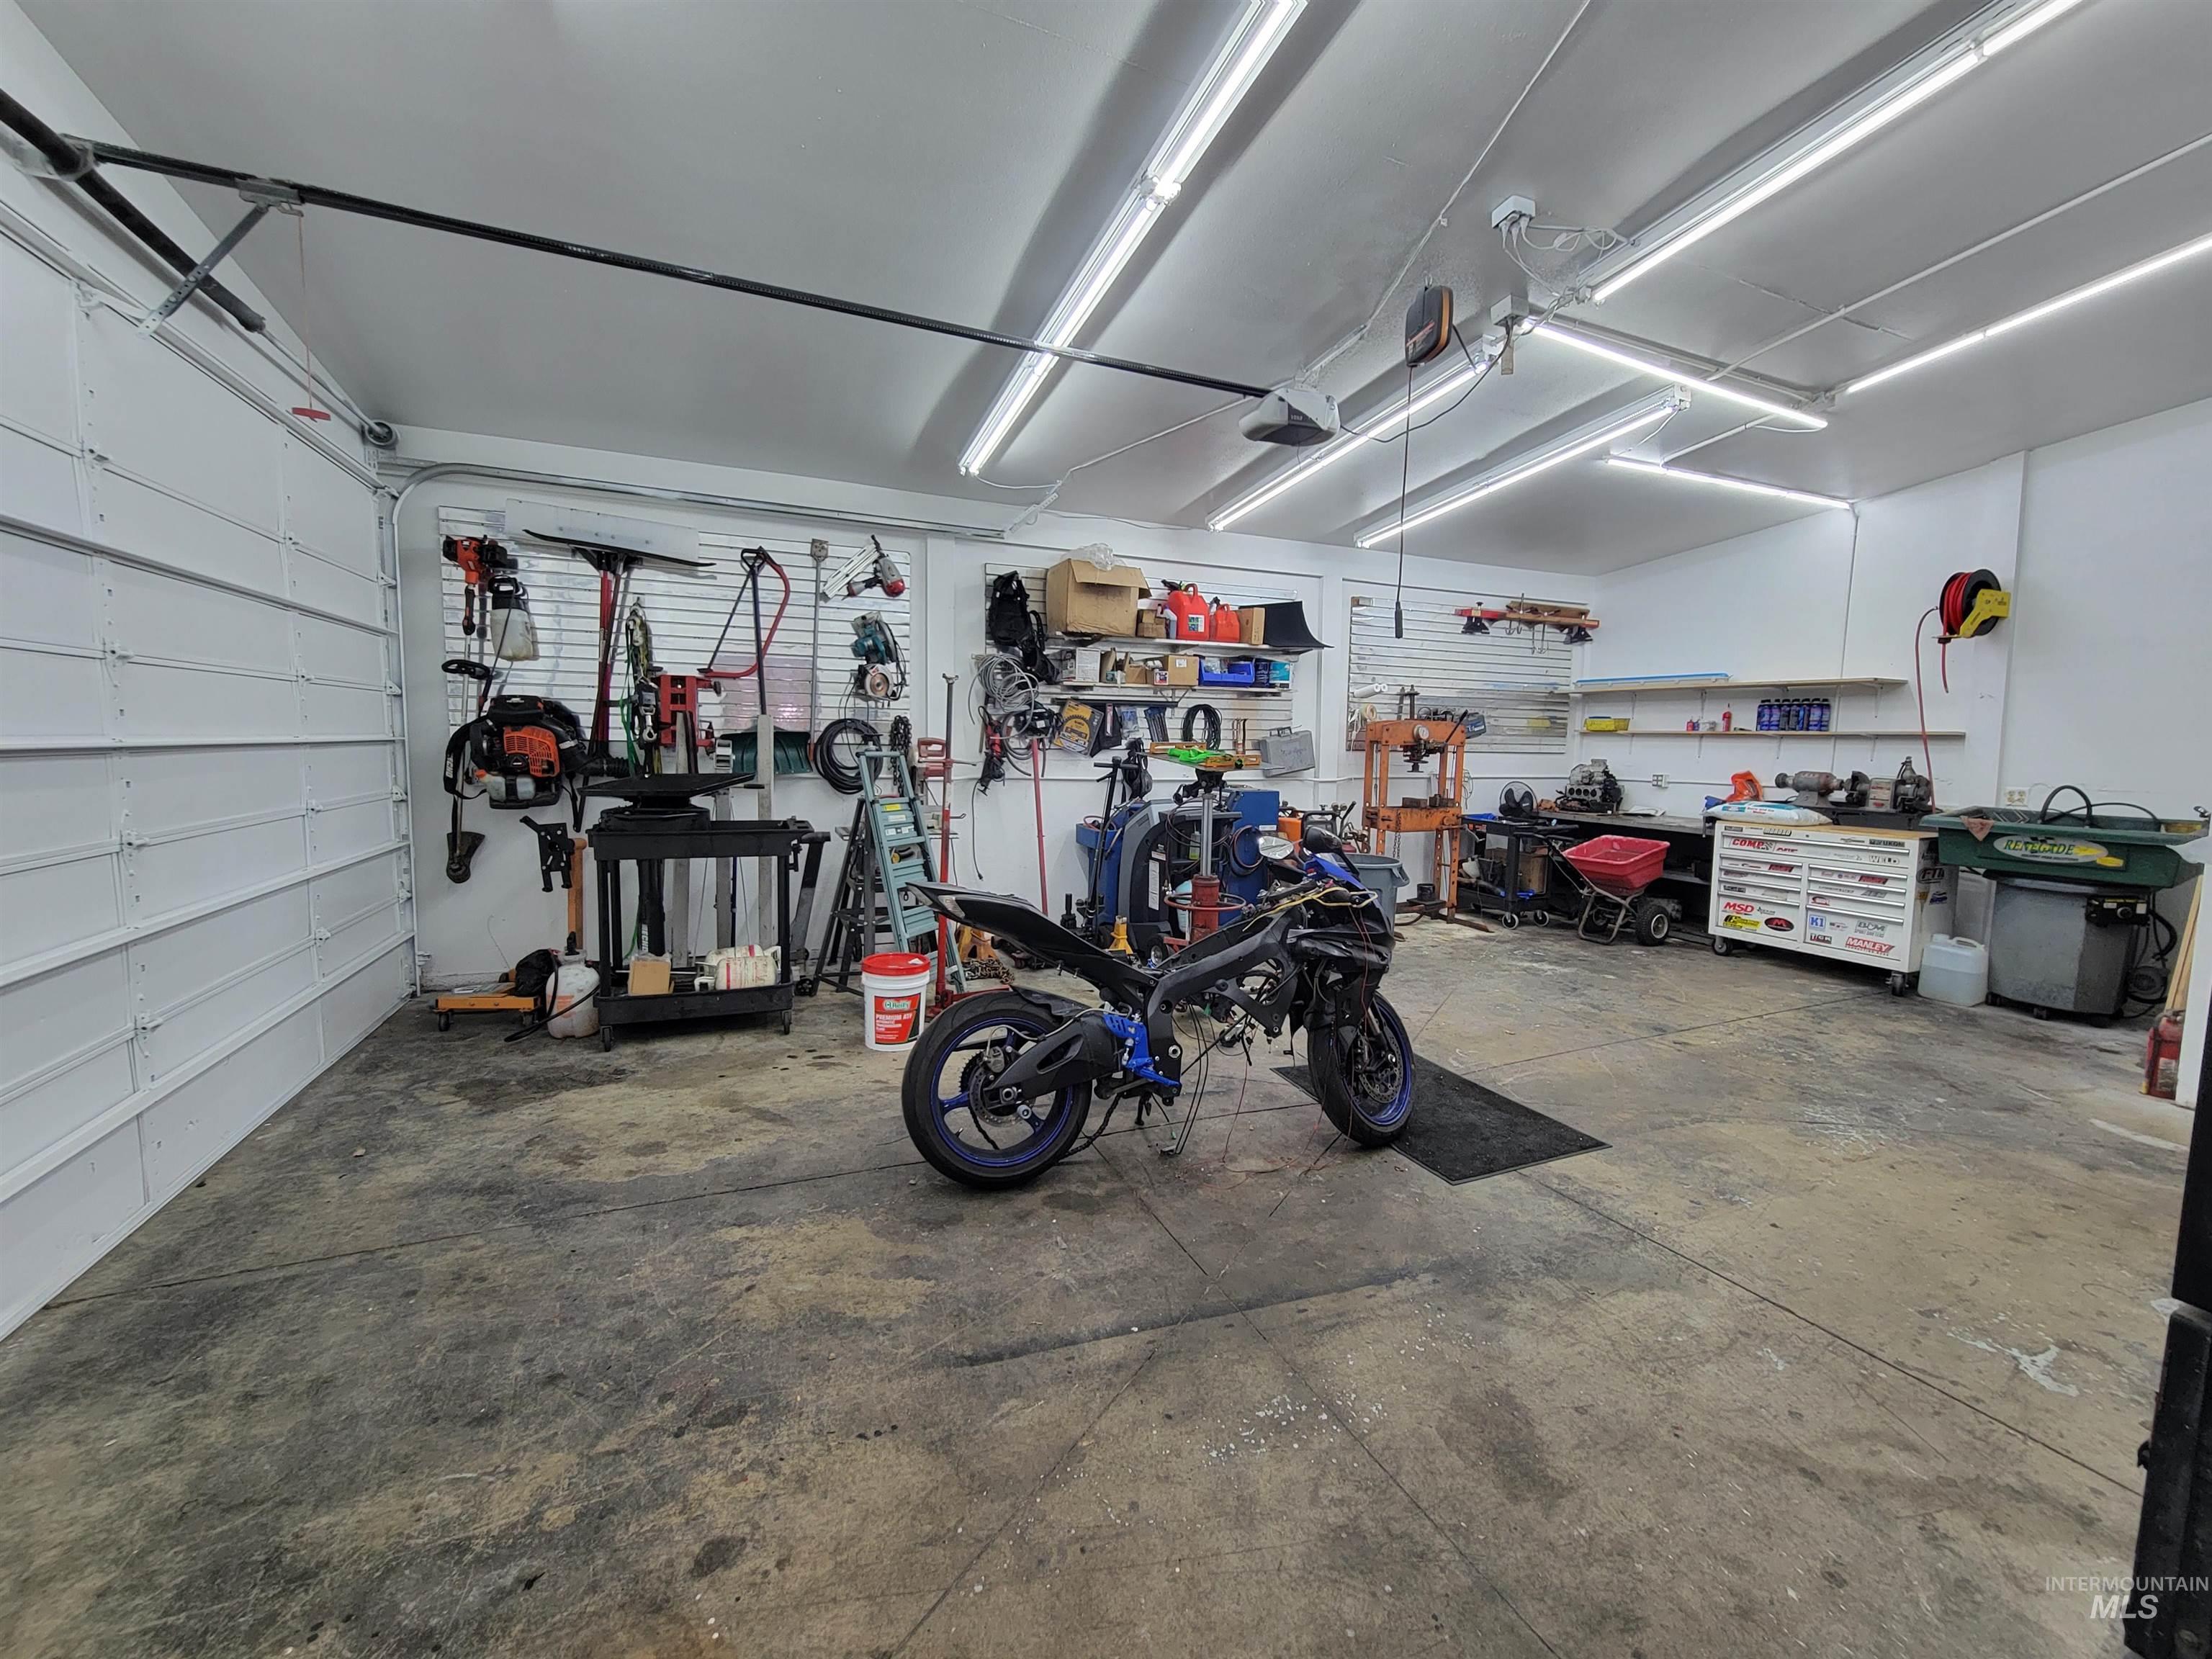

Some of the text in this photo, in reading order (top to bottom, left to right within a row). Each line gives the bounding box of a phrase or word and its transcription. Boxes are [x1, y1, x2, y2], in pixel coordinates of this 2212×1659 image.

[1732, 839, 1764, 848] COMP
[2004, 840, 2075, 855] RENEGADE
[1869, 855, 1899, 864] WELD
[1724, 902, 1755, 913] MSD
[1810, 917, 1824, 927] K1
[1848, 938, 1889, 952] MANLEY
